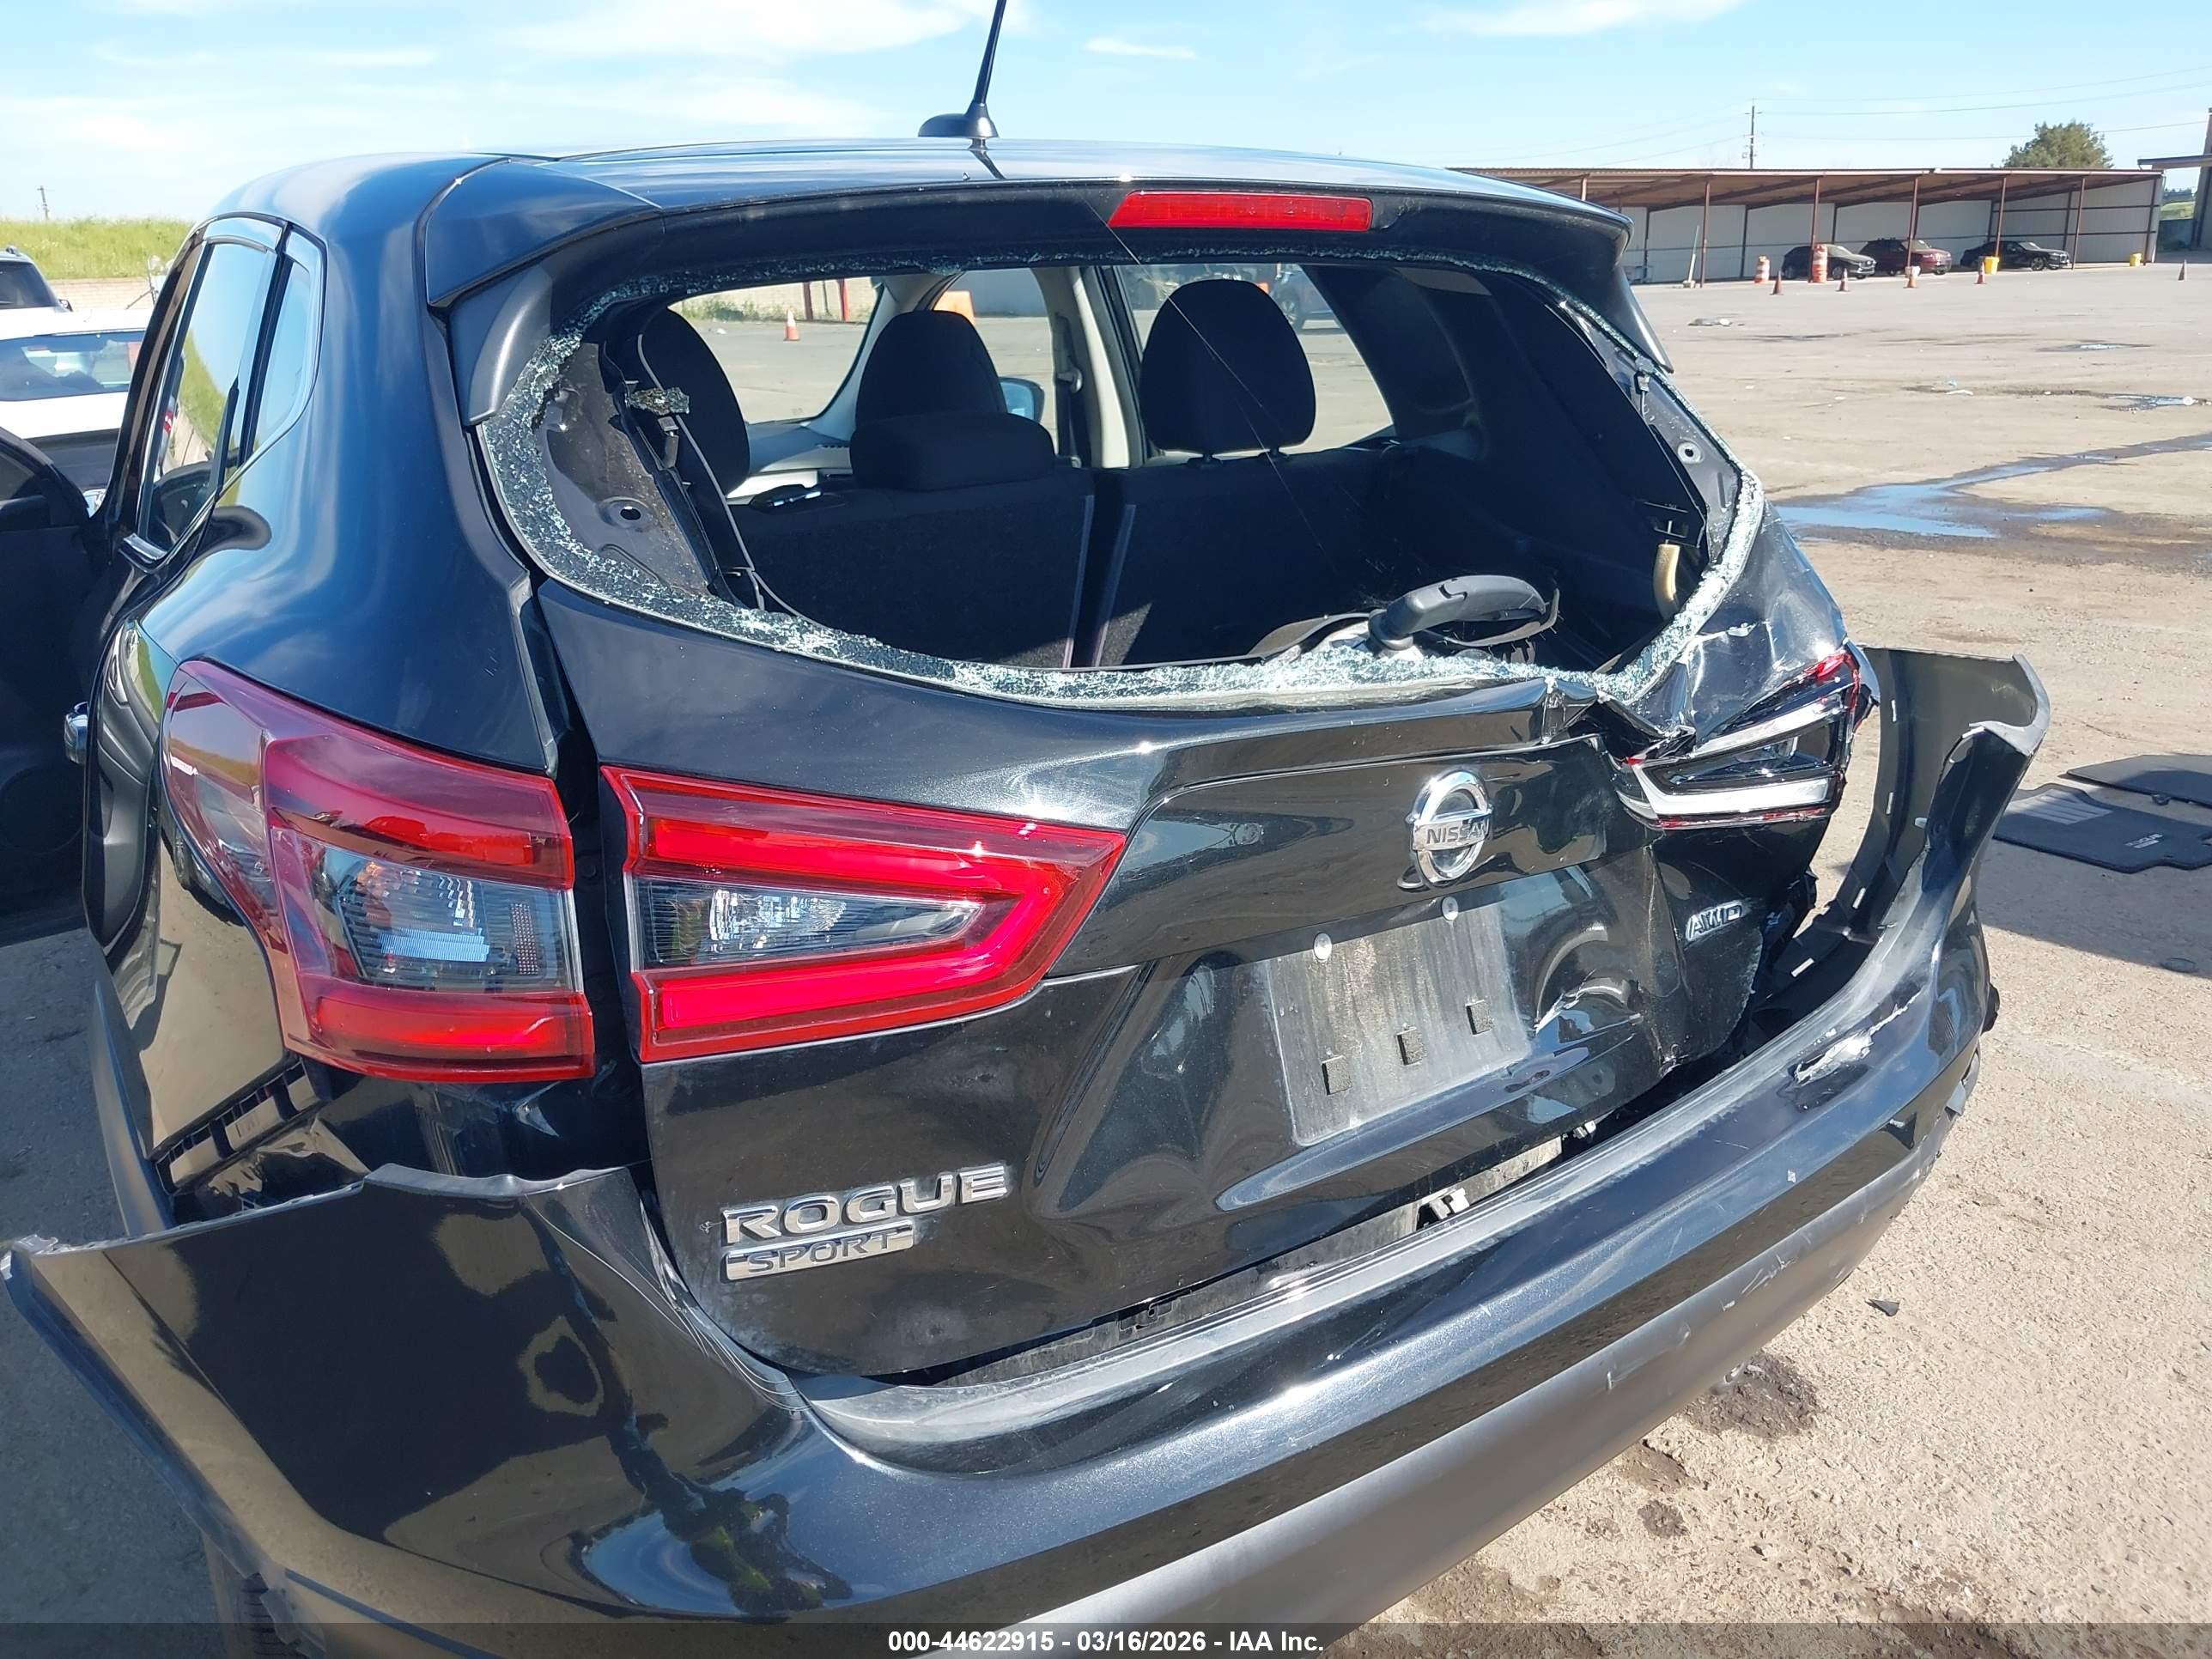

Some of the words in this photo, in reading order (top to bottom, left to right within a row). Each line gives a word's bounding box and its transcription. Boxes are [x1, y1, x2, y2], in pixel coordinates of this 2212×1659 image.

[1426, 819, 1487, 844] NISSAN
[1687, 903, 1743, 939] AWD
[723, 1165, 1008, 1245] ROGUE
[748, 1230, 898, 1273] SPORT
